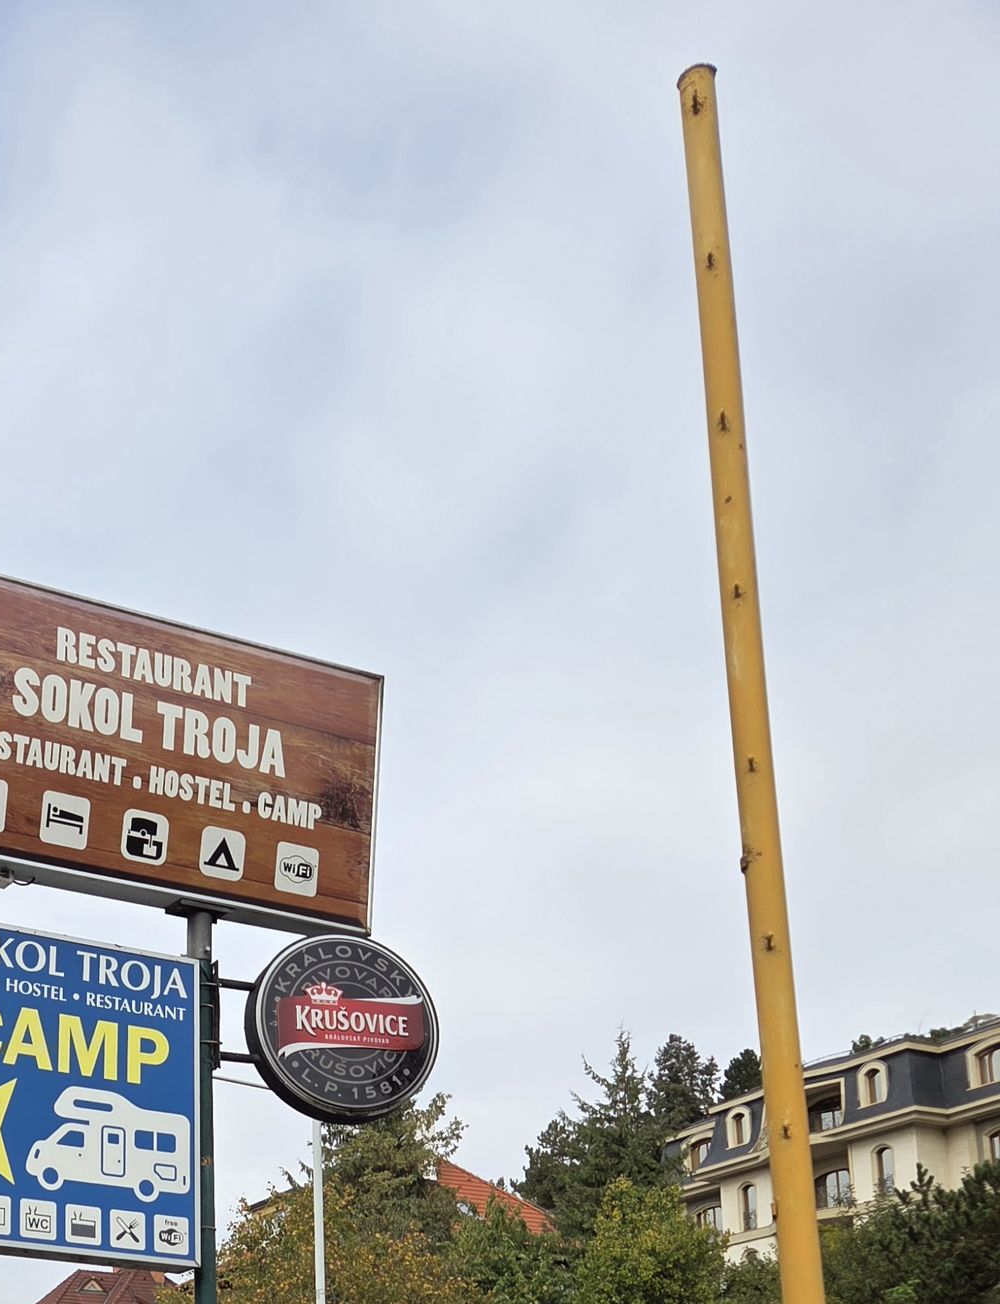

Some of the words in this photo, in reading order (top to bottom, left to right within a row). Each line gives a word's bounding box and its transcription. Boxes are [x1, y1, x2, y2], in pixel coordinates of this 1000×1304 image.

[56, 626, 252, 708] RESTAURANT
[13, 666, 143, 744] SOKOL
[157, 700, 286, 778] TROJA
[149, 765, 236, 812] HOSTEL
[257, 791, 323, 830] CAMP
[77, 949, 188, 1000] TROJA
[6, 978, 67, 1003] HOSTEL
[86, 992, 186, 1021] RESTAURANT
[295, 1005, 410, 1037] KRUŠOVICE
[305, 1050, 398, 1078] RUŠOVIC
[352, 1075, 402, 1100] 1581
[28, 1217, 49, 1230] WC
[164, 1219, 178, 1227] free
